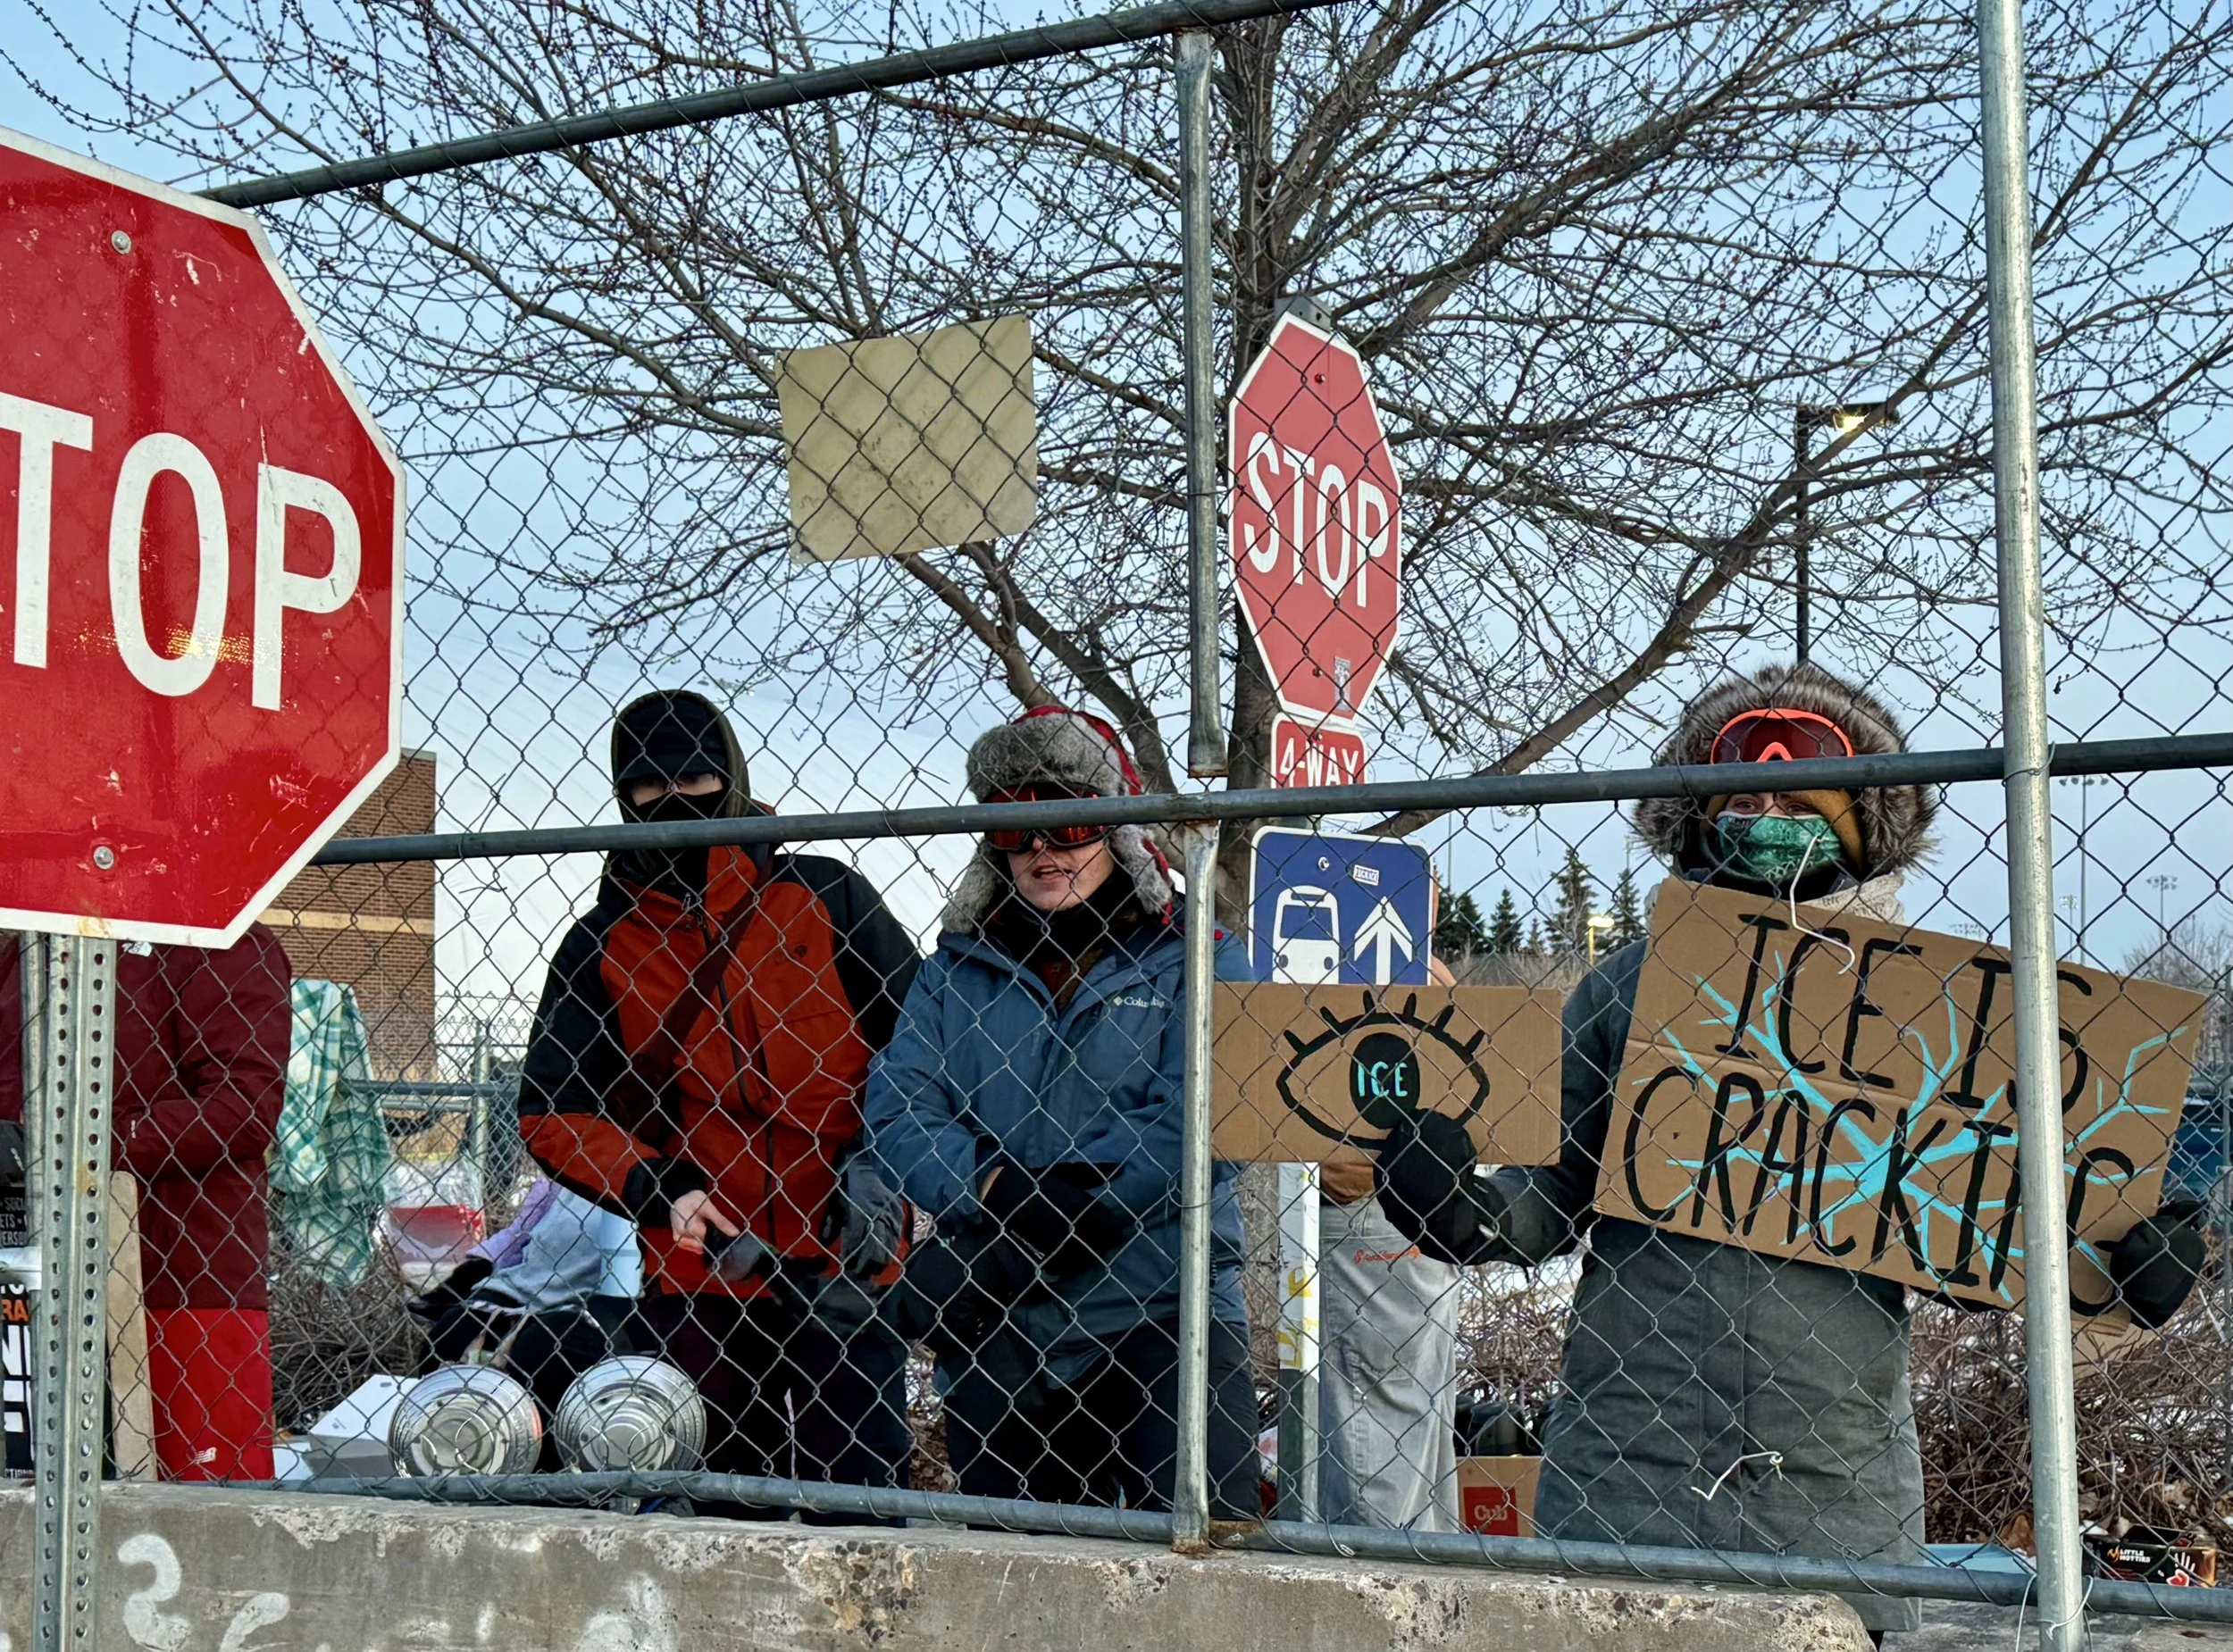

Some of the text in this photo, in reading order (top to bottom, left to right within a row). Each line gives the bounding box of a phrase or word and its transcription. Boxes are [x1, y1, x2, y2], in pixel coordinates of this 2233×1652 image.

[0, 393, 361, 712] TOP
[1243, 431, 1390, 608] STOP
[1280, 737, 1359, 788] 4-WAY
[1358, 1060, 1408, 1098] ICE
[1714, 913, 1923, 1089] ICE
